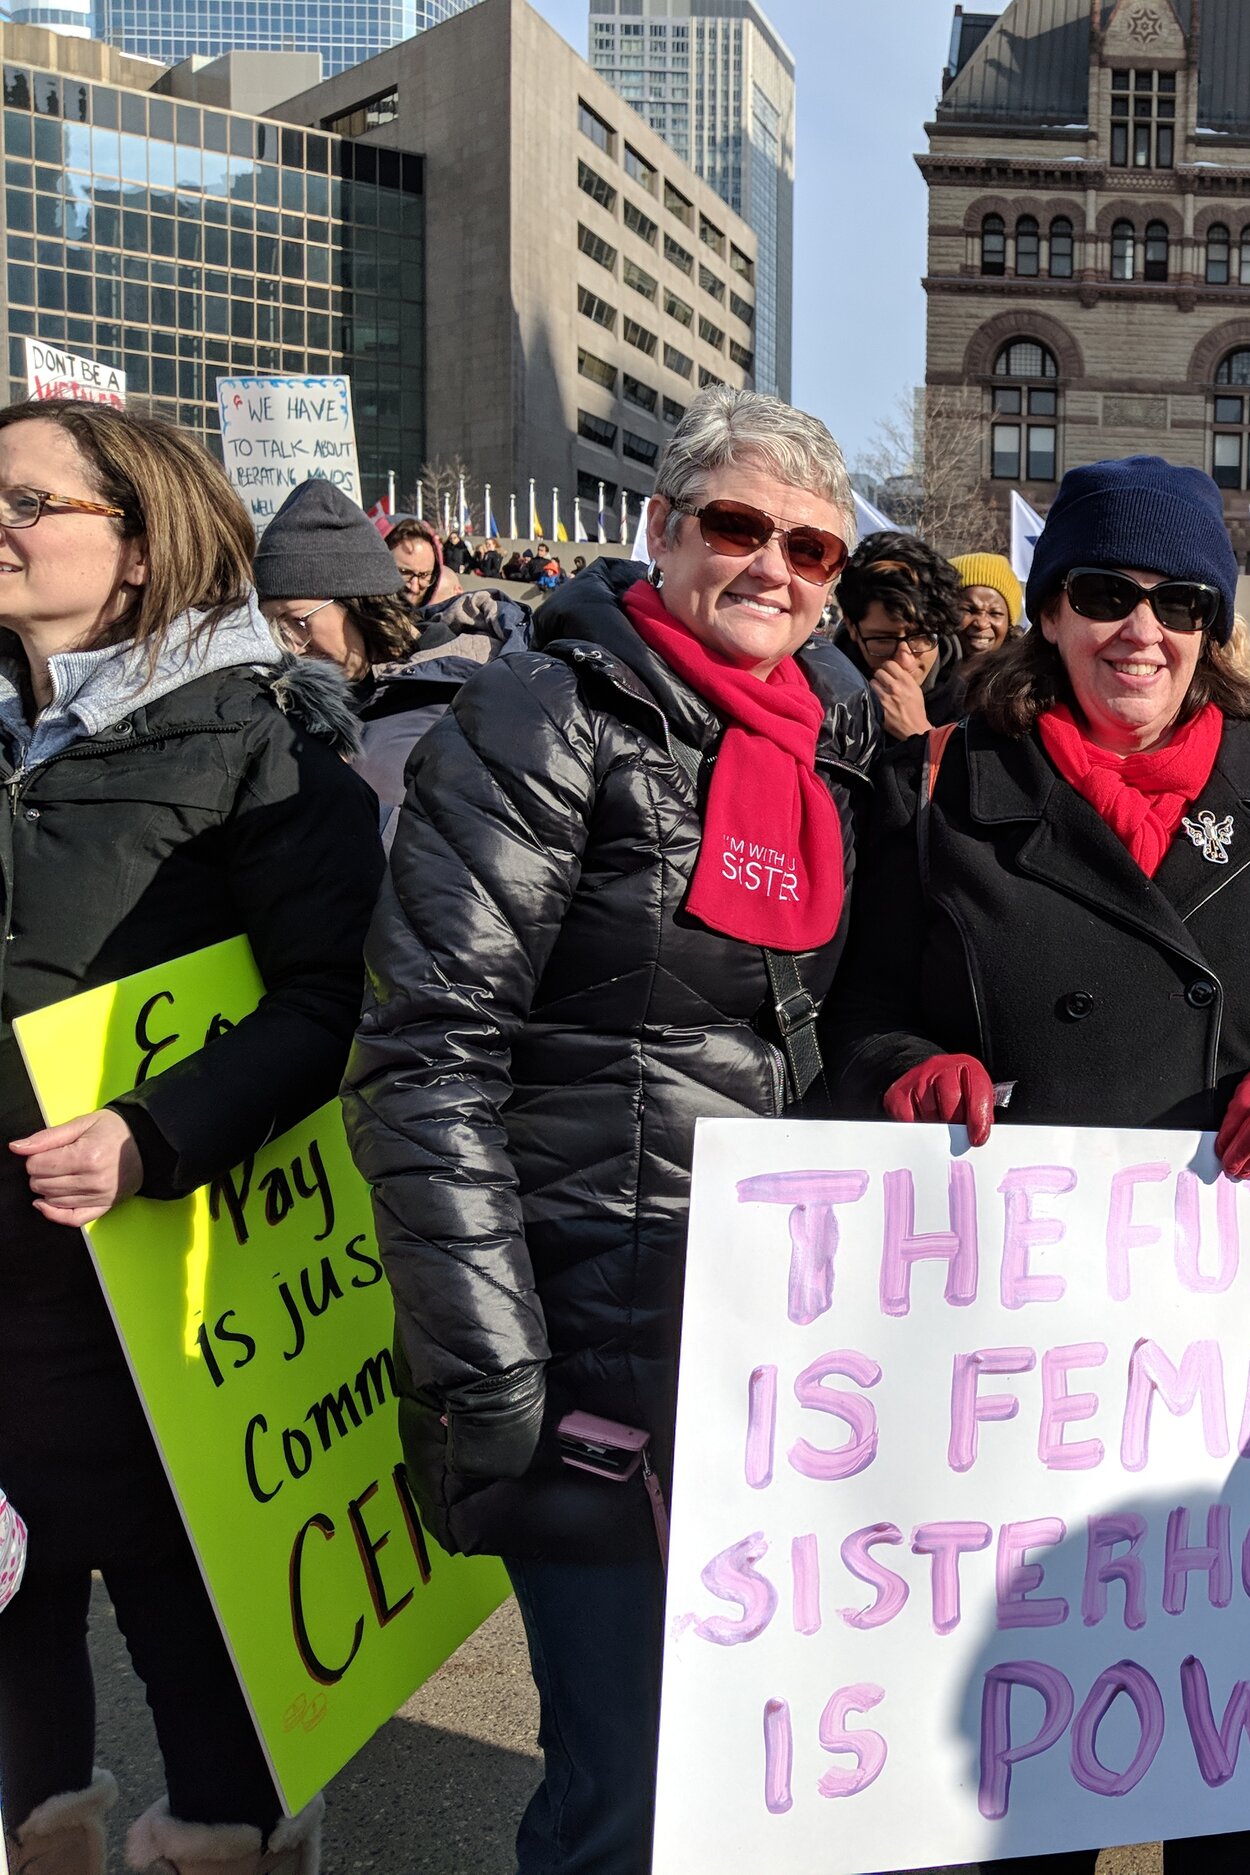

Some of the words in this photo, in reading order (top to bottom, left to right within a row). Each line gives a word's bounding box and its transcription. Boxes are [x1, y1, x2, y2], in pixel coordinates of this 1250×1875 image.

[80, 361, 101, 386] BE
[107, 371, 120, 391] A
[247, 396, 274, 422] WE
[287, 397, 338, 422] HAVE
[228, 438, 253, 457] TO
[256, 439, 310, 459] TALK
[313, 439, 354, 459] ABOUT
[749, 842, 785, 867] WITH
[733, 1159, 1079, 1326] THE
[194, 1308, 256, 1388] is
[271, 1233, 385, 1361] jus
[244, 1347, 401, 1504] Comm
[744, 1348, 884, 1490] IS
[762, 1682, 889, 1816] IS
